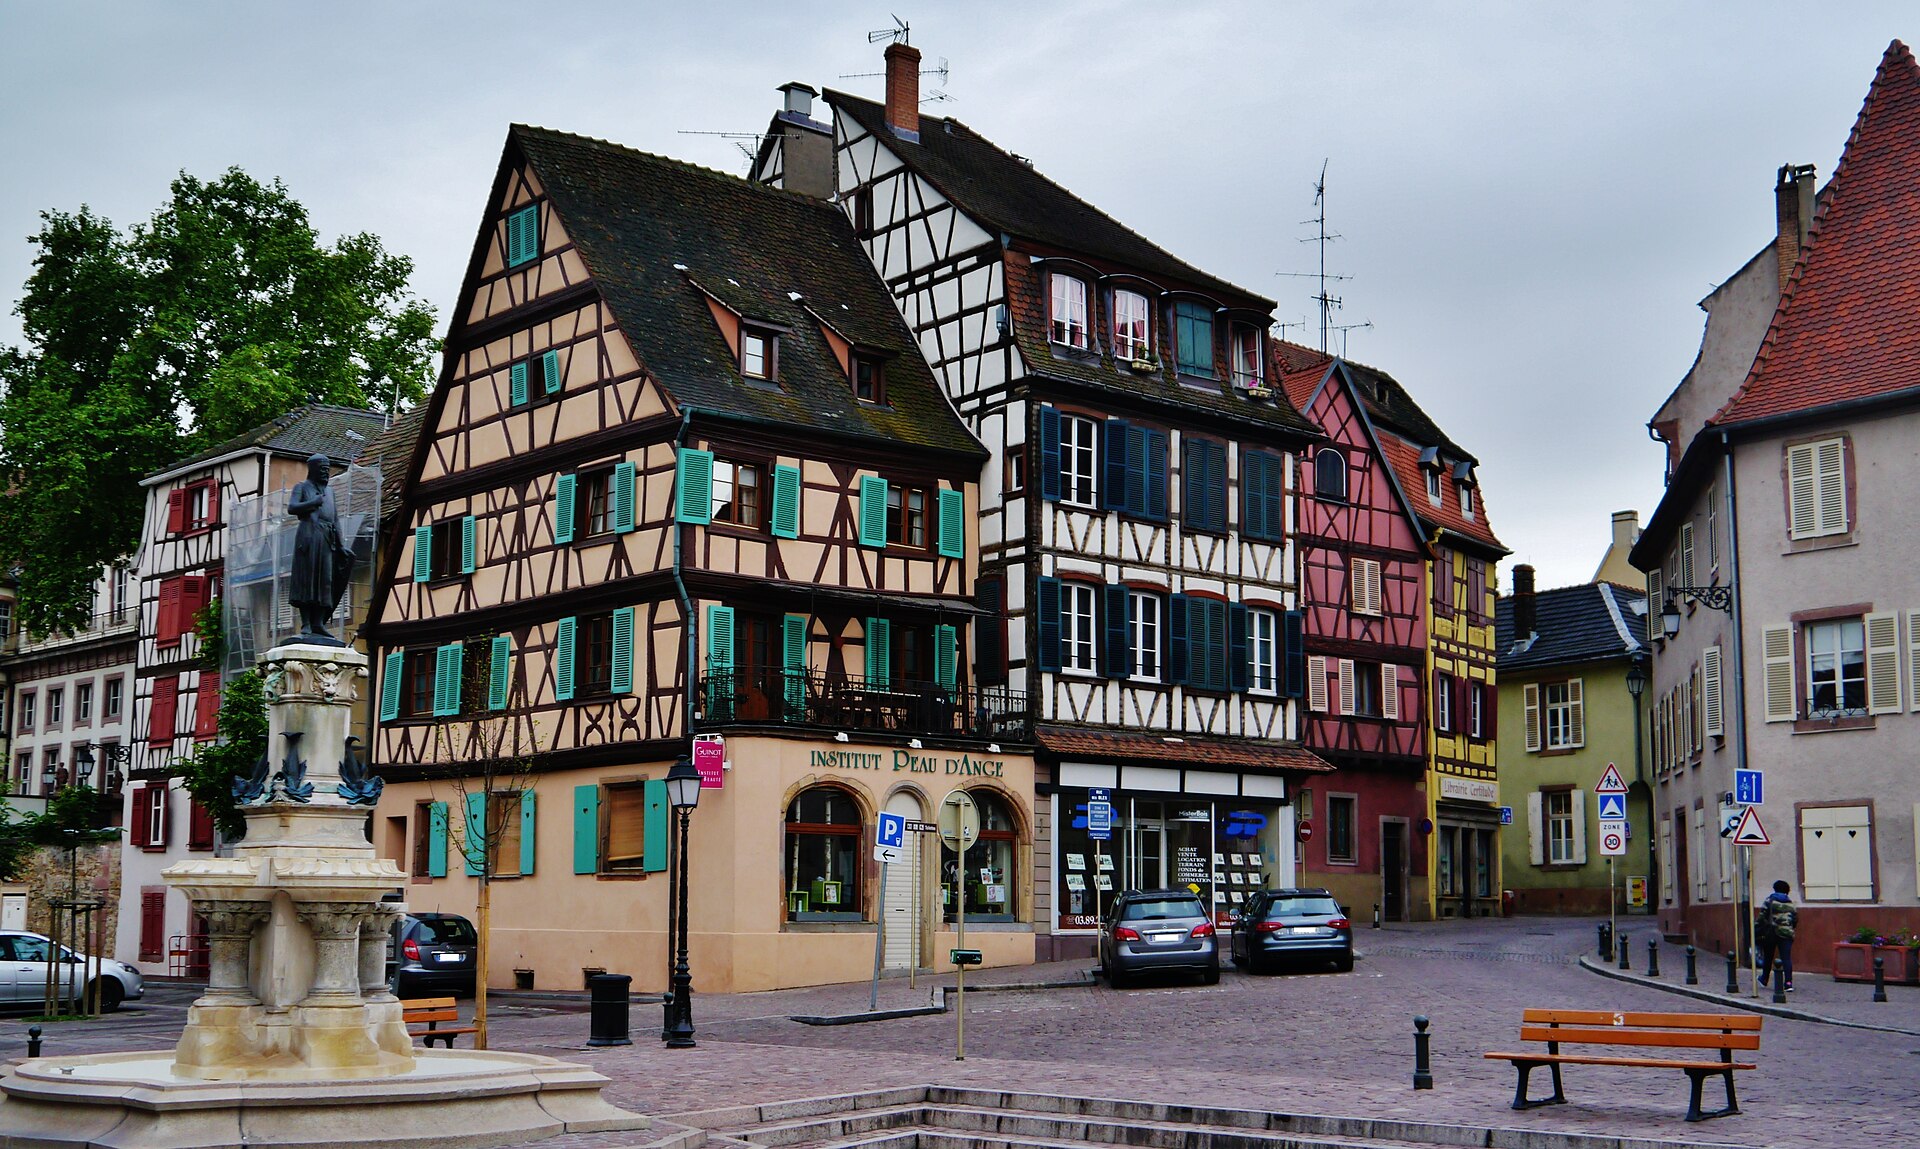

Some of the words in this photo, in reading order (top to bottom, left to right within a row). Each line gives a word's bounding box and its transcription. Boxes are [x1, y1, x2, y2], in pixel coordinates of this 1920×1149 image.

[696, 746, 721, 756] GUINOT
[810, 750, 881, 770] INSTITUT
[892, 749, 937, 773] PEAU
[945, 753, 1003, 777] D'ANGE
[884, 819, 898, 841] P
[1607, 838, 1618, 846] 30
